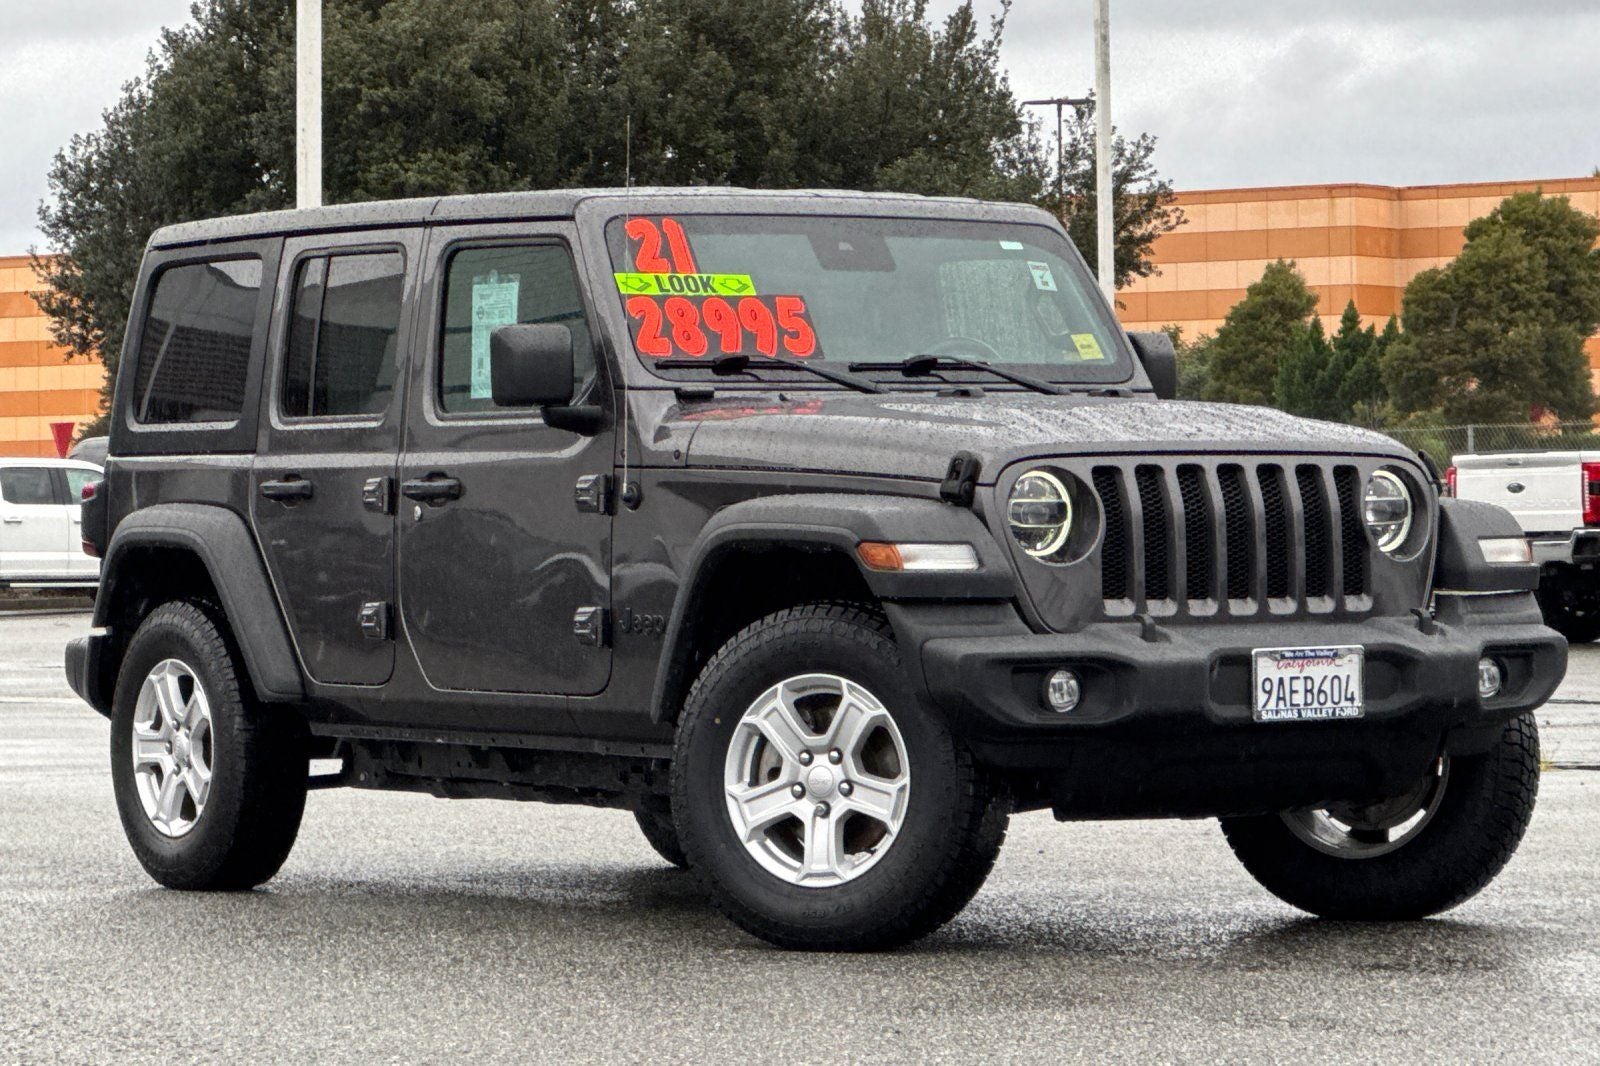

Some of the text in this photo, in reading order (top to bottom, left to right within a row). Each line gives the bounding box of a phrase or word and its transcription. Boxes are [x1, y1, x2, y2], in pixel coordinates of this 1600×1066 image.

[625, 218, 697, 273] 21
[654, 275, 717, 293] LOOK
[626, 296, 815, 356] 28995
[619, 607, 665, 637] Jeep
[1261, 674, 1356, 708] 9AEB604
[1301, 708, 1333, 718] VALLEY
